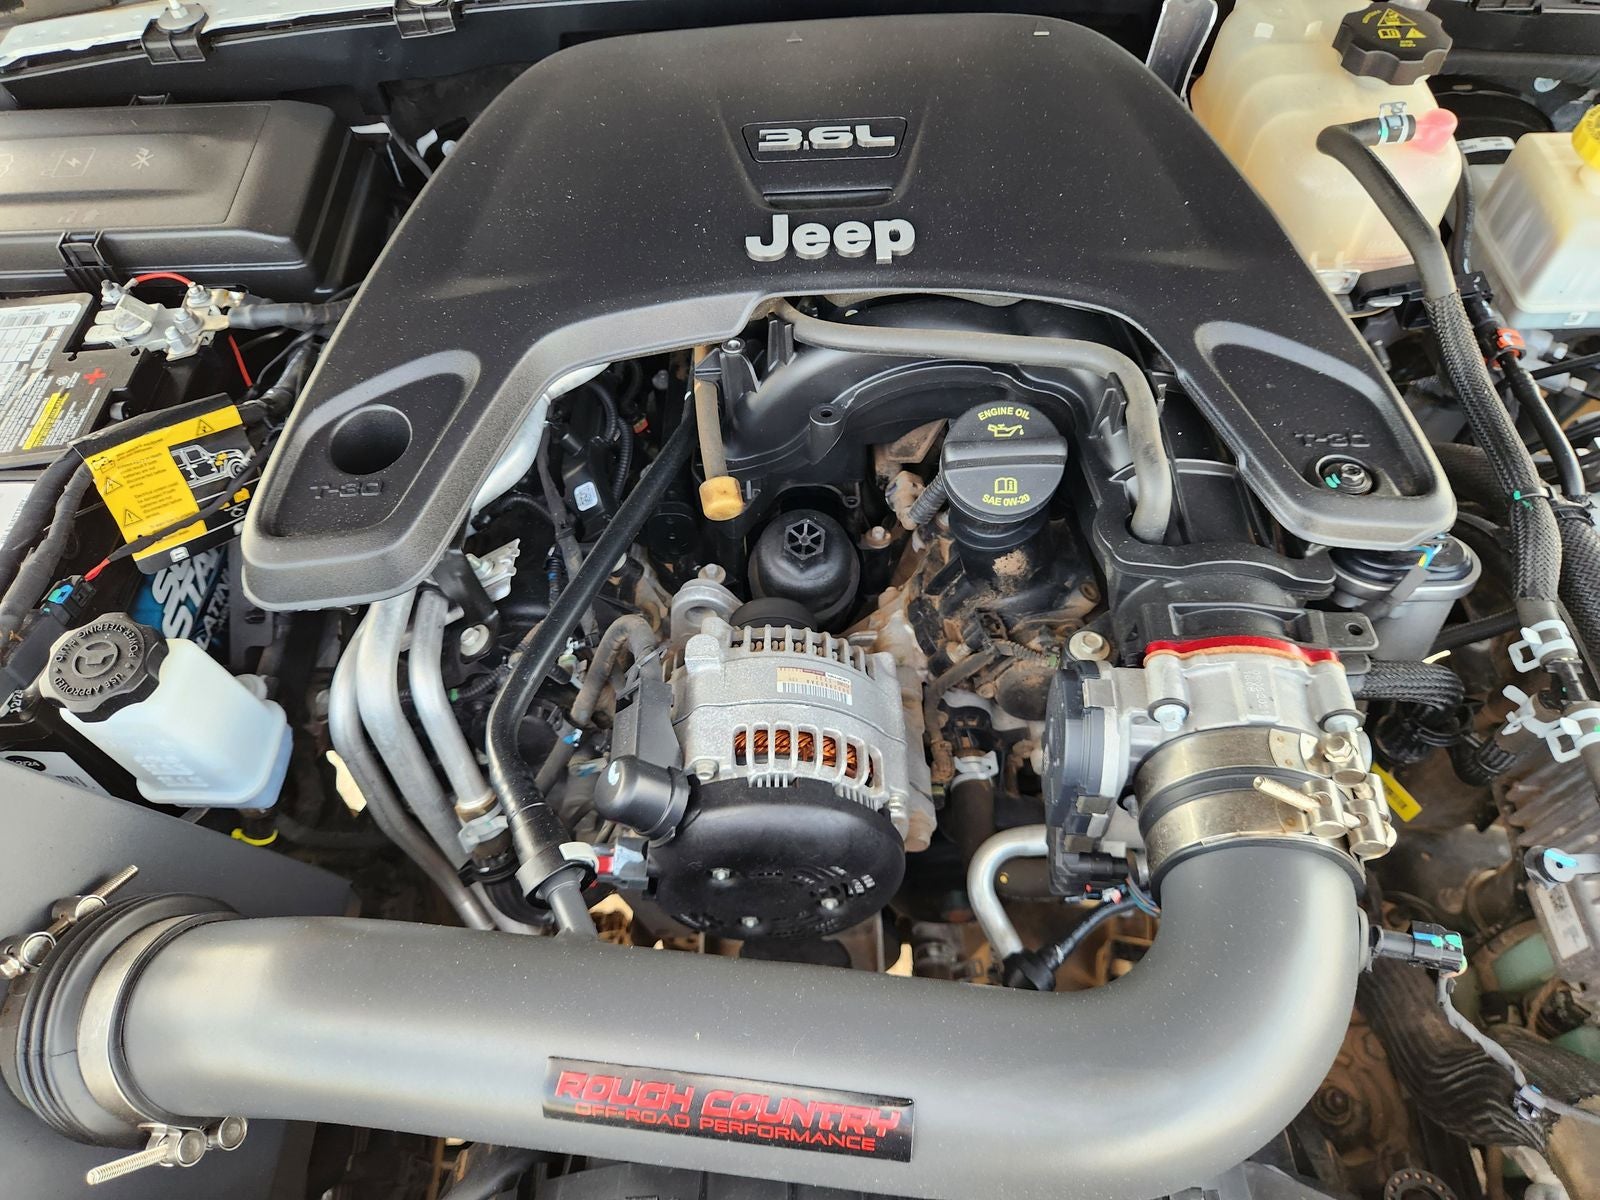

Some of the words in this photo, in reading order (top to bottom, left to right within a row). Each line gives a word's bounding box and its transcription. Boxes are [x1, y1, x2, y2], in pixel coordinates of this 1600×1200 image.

[758, 125, 896, 152] 3.6L
[745, 214, 915, 264] Jeep
[977, 406, 1014, 421] ENGINE
[1015, 407, 1031, 420] OIL
[982, 494, 1001, 506] SAE
[1003, 493, 1031, 507] 0W-20
[77, 622, 125, 639] STEERING
[123, 628, 140, 658] POWER
[54, 676, 102, 697] APPROVED
[104, 671, 125, 688] USE
[554, 1070, 696, 1112] ROUGH
[700, 1089, 901, 1138] COUNTRY
[574, 1101, 690, 1129] OFF-ROAD
[698, 1116, 876, 1152] PERFORMANCE
